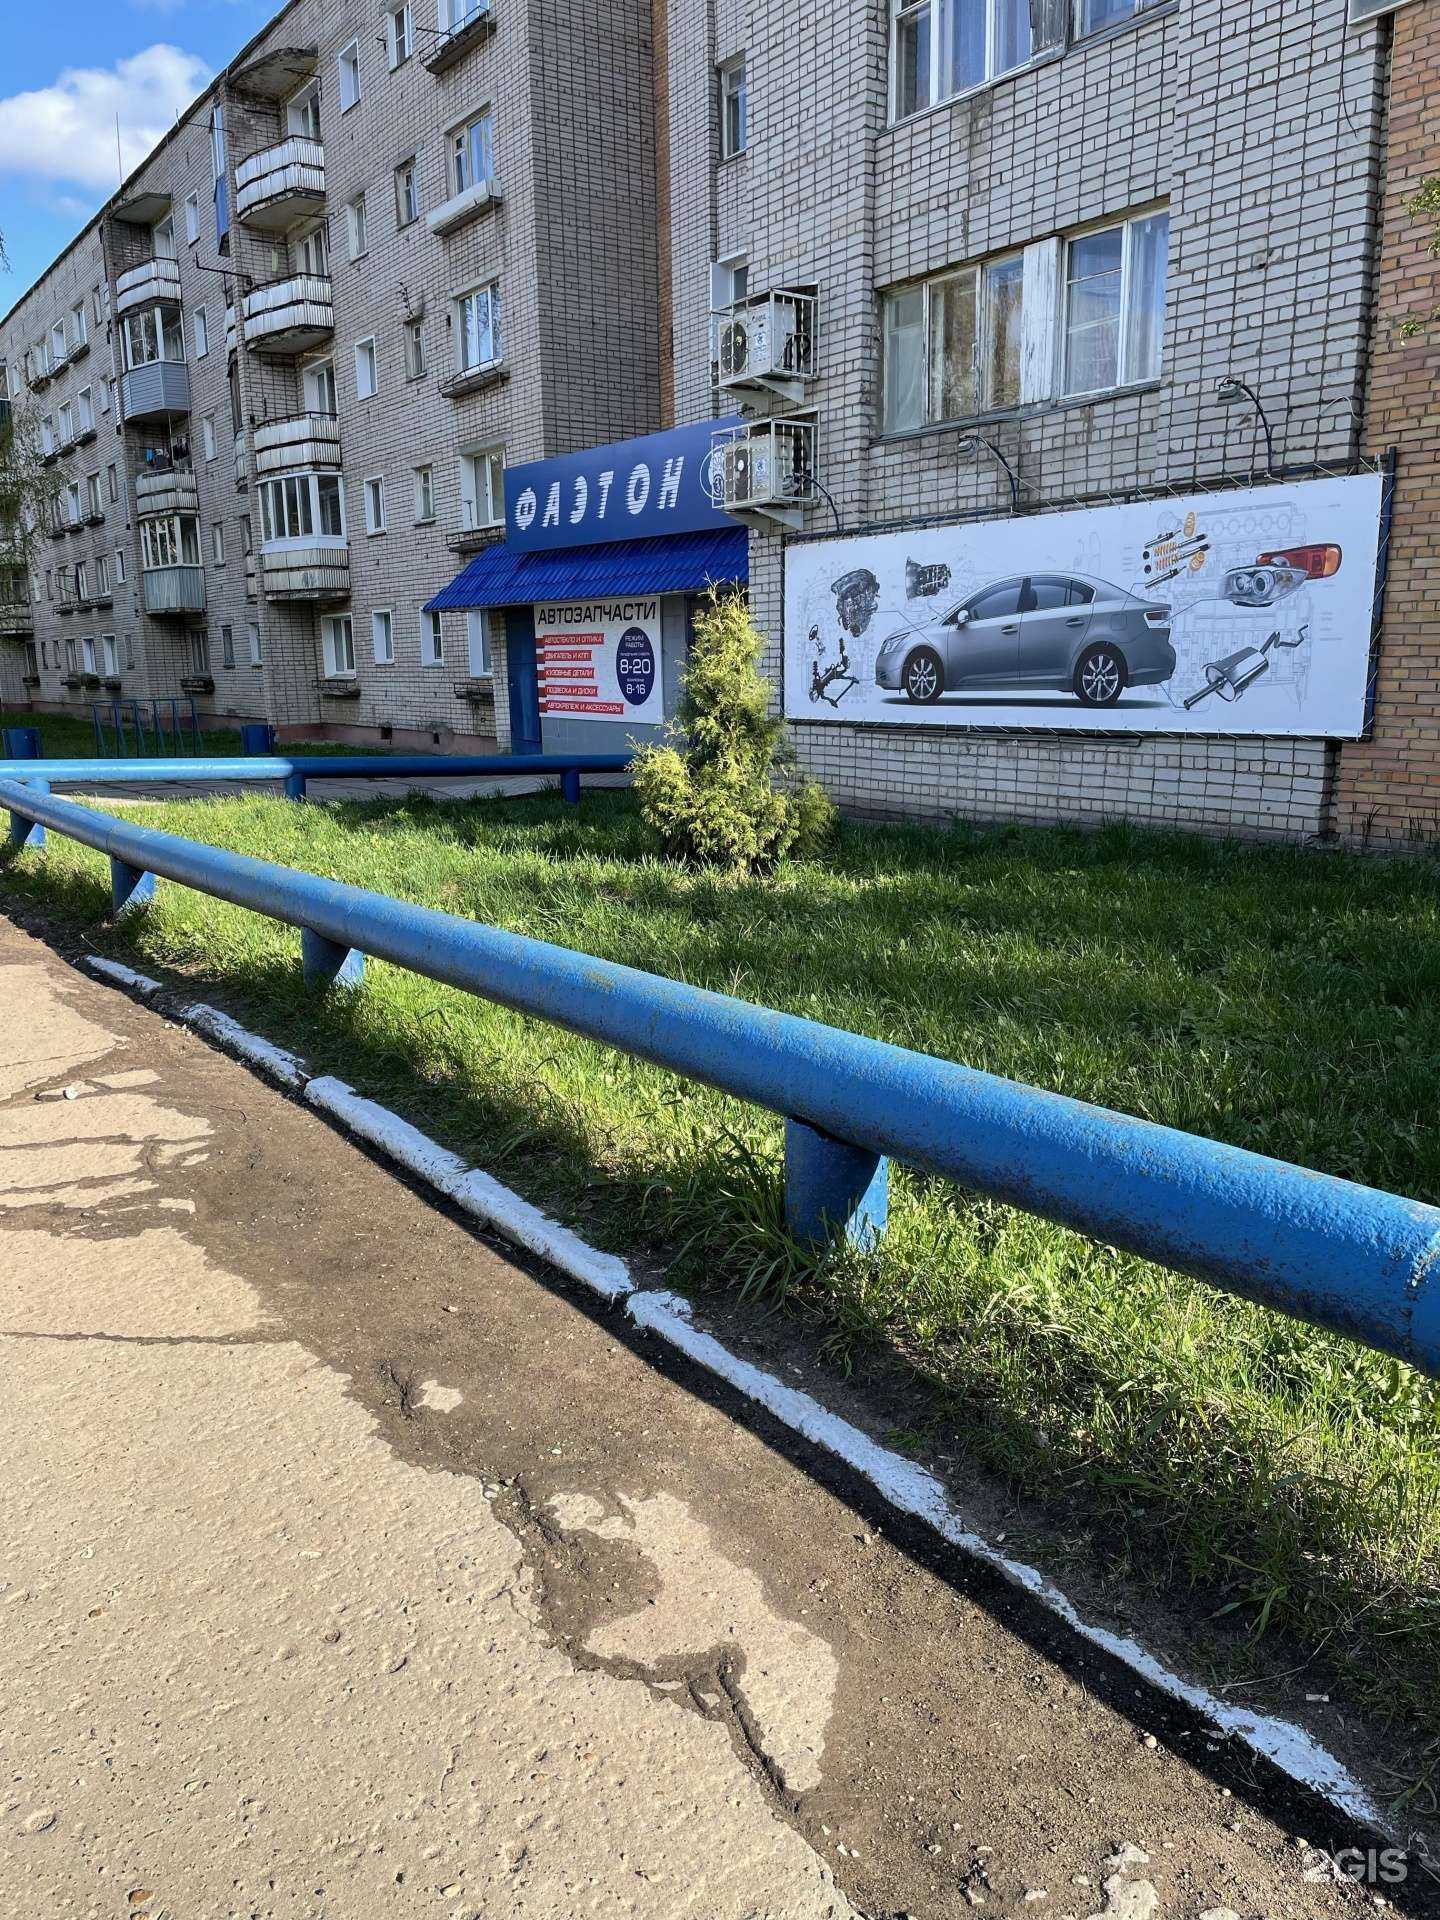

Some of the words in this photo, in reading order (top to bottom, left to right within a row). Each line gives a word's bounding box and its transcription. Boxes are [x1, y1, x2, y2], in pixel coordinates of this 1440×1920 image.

[514, 456, 685, 531] ФАЭТОН
[538, 602, 657, 625] АВТОЗАПЧАСТИ
[545, 652, 572, 660] ДВИГАТЕЛЬ
[620, 658, 651, 674] 8-20
[545, 669, 571, 677] КУЗОВНЫЕ
[572, 669, 593, 678] ДЕТАЛИ
[626, 683, 646, 694] 8-16
[586, 704, 621, 713] АКСЕССУАРЫ
